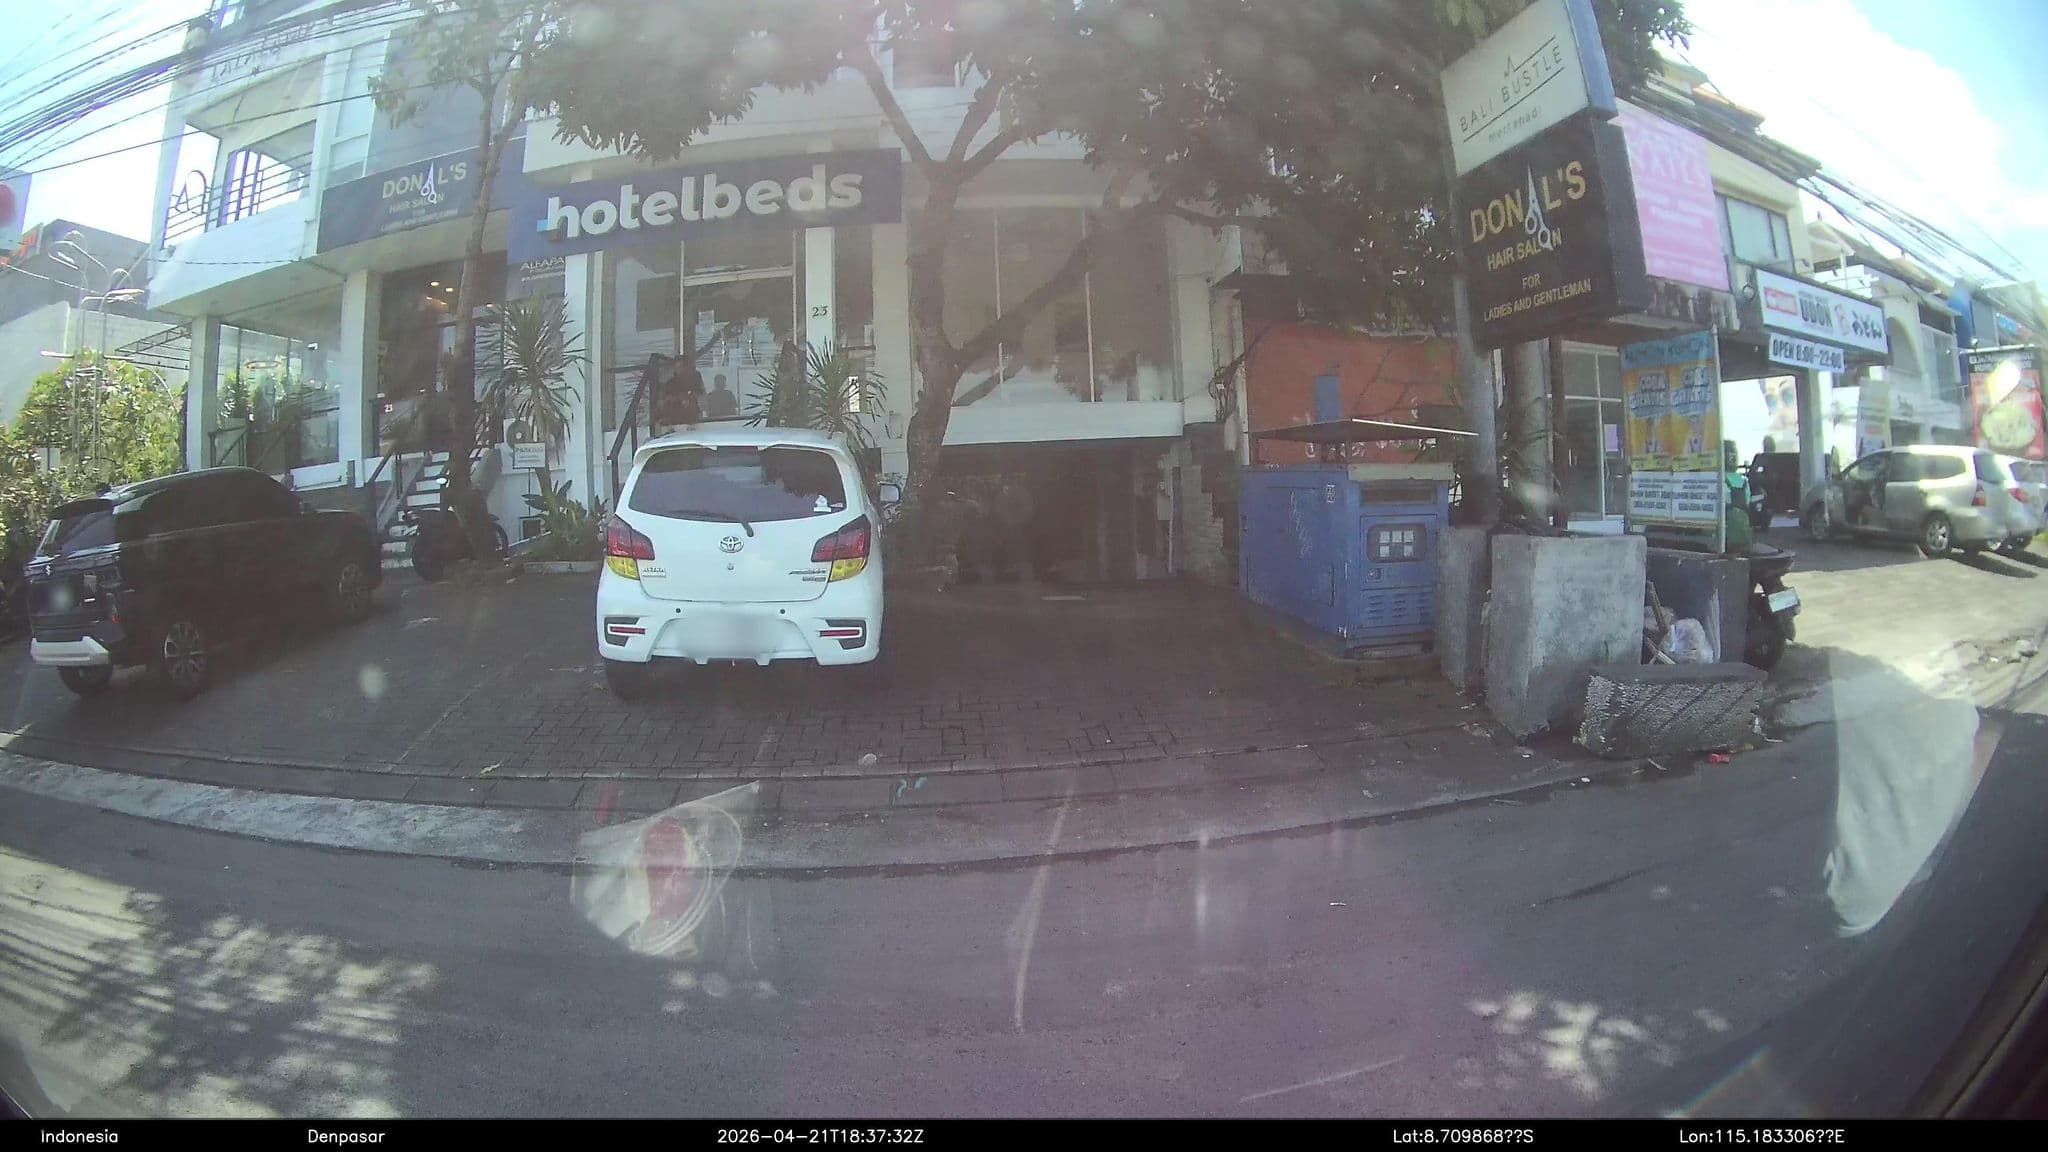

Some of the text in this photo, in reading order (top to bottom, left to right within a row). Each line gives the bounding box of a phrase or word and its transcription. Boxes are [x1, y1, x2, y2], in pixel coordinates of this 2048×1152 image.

[1460, 45, 1562, 132] BALI BUSTLE
[548, 164, 863, 238] hotelbeds
[1488, 228, 1562, 271] HAIR SALON
[1484, 278, 1592, 323] LADIES AND GENTLEMAN
[1522, 273, 1541, 289] FOR
[812, 306, 828, 317] 23
[1773, 339, 1794, 360] OPEN
